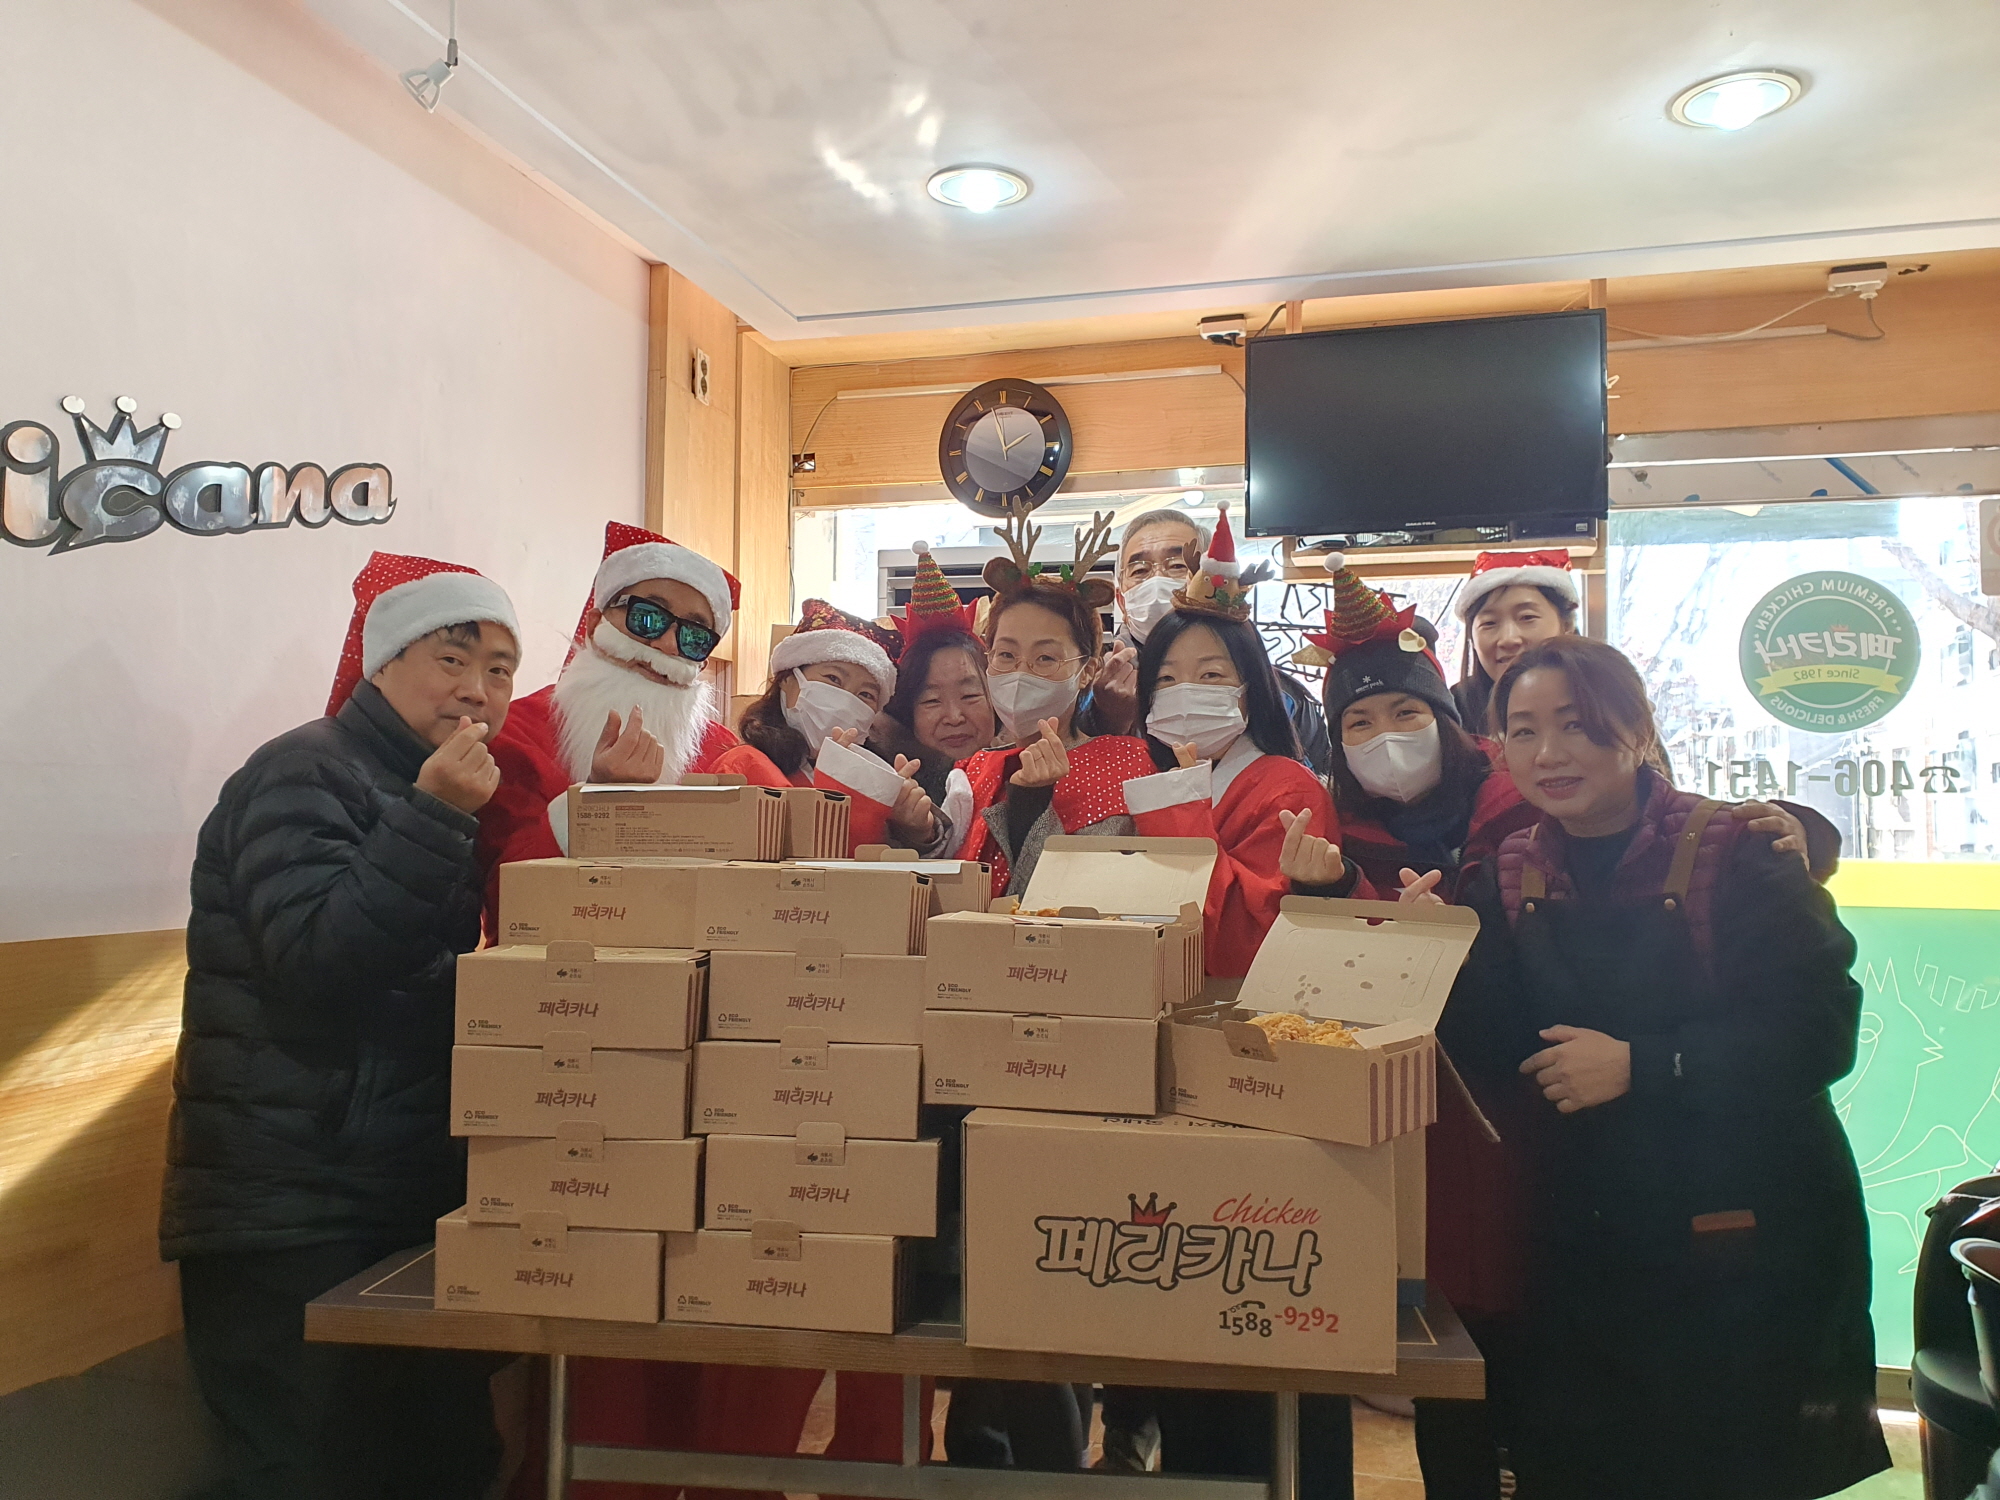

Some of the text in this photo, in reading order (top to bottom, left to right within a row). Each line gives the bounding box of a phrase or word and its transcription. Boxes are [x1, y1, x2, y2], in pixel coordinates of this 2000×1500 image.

[572, 904, 626, 920] 페리카나
[772, 908, 830, 924] 페리카나
[1006, 966, 1068, 984] 페리카나
[538, 1001, 599, 1018] 페리카나
[787, 996, 845, 1012] 페리카나
[1005, 1061, 1067, 1079] 페리카나
[1228, 1076, 1285, 1100] 페리카나
[535, 1091, 597, 1108] 페리카나
[773, 1089, 833, 1106] 페리카나
[550, 1180, 610, 1197] 페리카나
[789, 1185, 850, 1203] 페리카나
[1212, 1193, 1322, 1225] Chicken
[1034, 1215, 1322, 1297] 페리카나
[514, 1269, 574, 1287] 페리카나
[746, 1279, 807, 1298] 페리카나
[1219, 1305, 1339, 1338] 1588-9292
